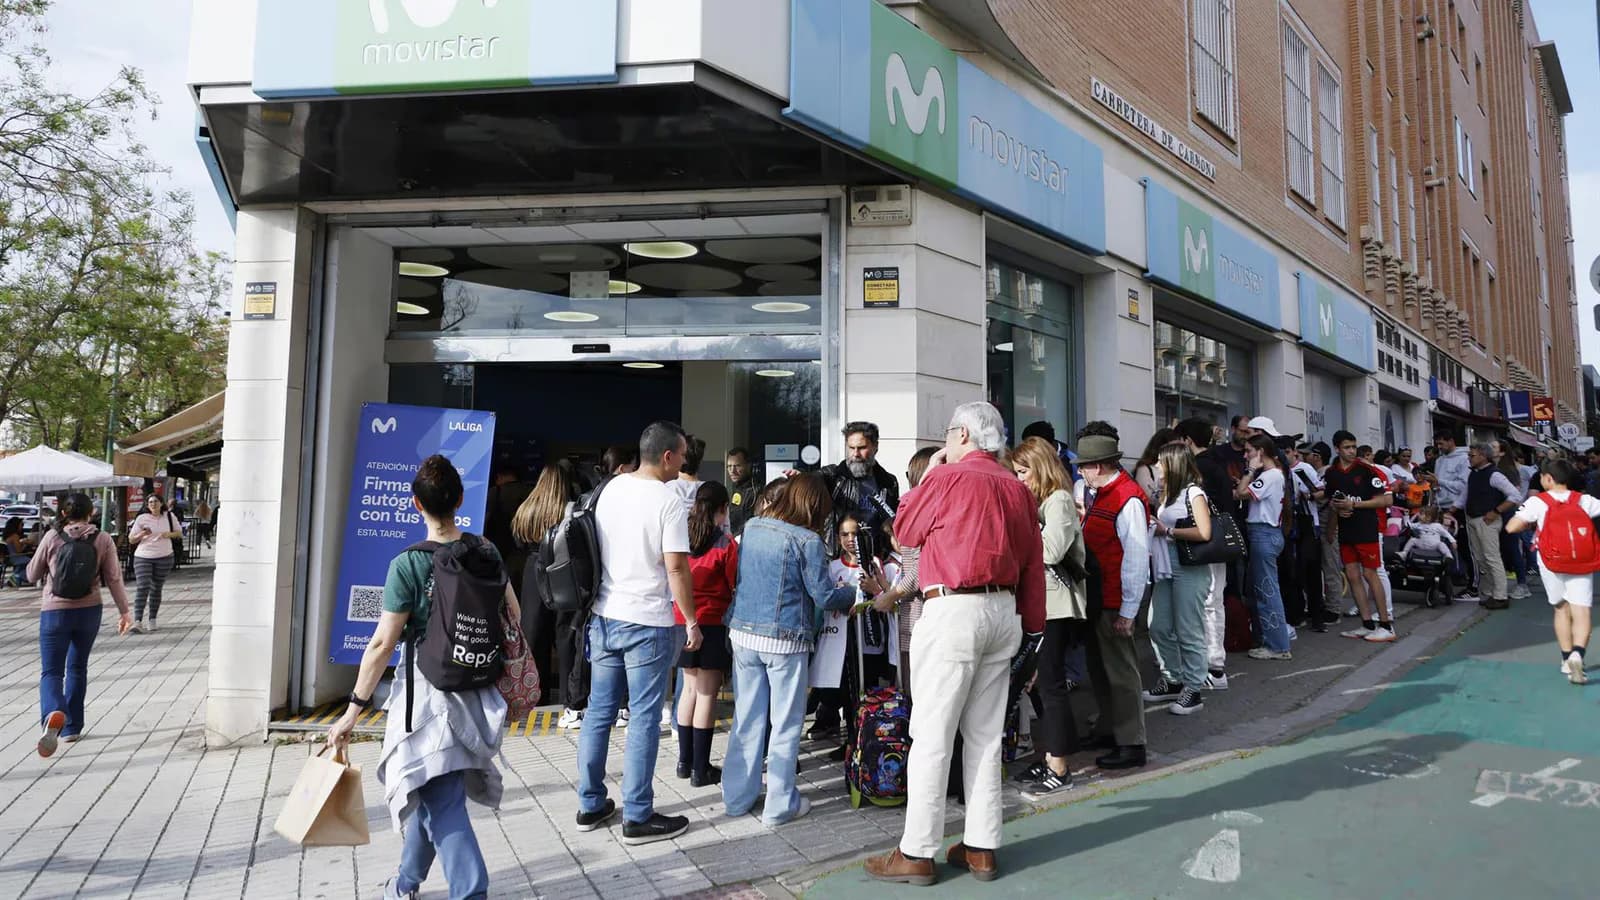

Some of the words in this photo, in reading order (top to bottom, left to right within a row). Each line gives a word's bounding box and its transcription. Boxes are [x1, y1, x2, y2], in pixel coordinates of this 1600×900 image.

[362, 33, 500, 65] movistar
[1093, 81, 1157, 138] CARRETERA
[1161, 130, 1174, 150] DE
[1178, 143, 1216, 180] CARMONA
[968, 114, 1070, 196] movistar
[448, 421, 483, 432] LALIGA
[363, 475, 413, 493] Firma
[361, 493, 416, 511] autógr
[359, 509, 391, 521] con
[394, 510, 420, 524] tus
[357, 528, 378, 537] ESTA
[380, 529, 407, 539] TARDE
[456, 612, 476, 624] Wake
[455, 622, 474, 633] Work
[454, 631, 470, 642] Feel
[343, 642, 368, 650] Movis
